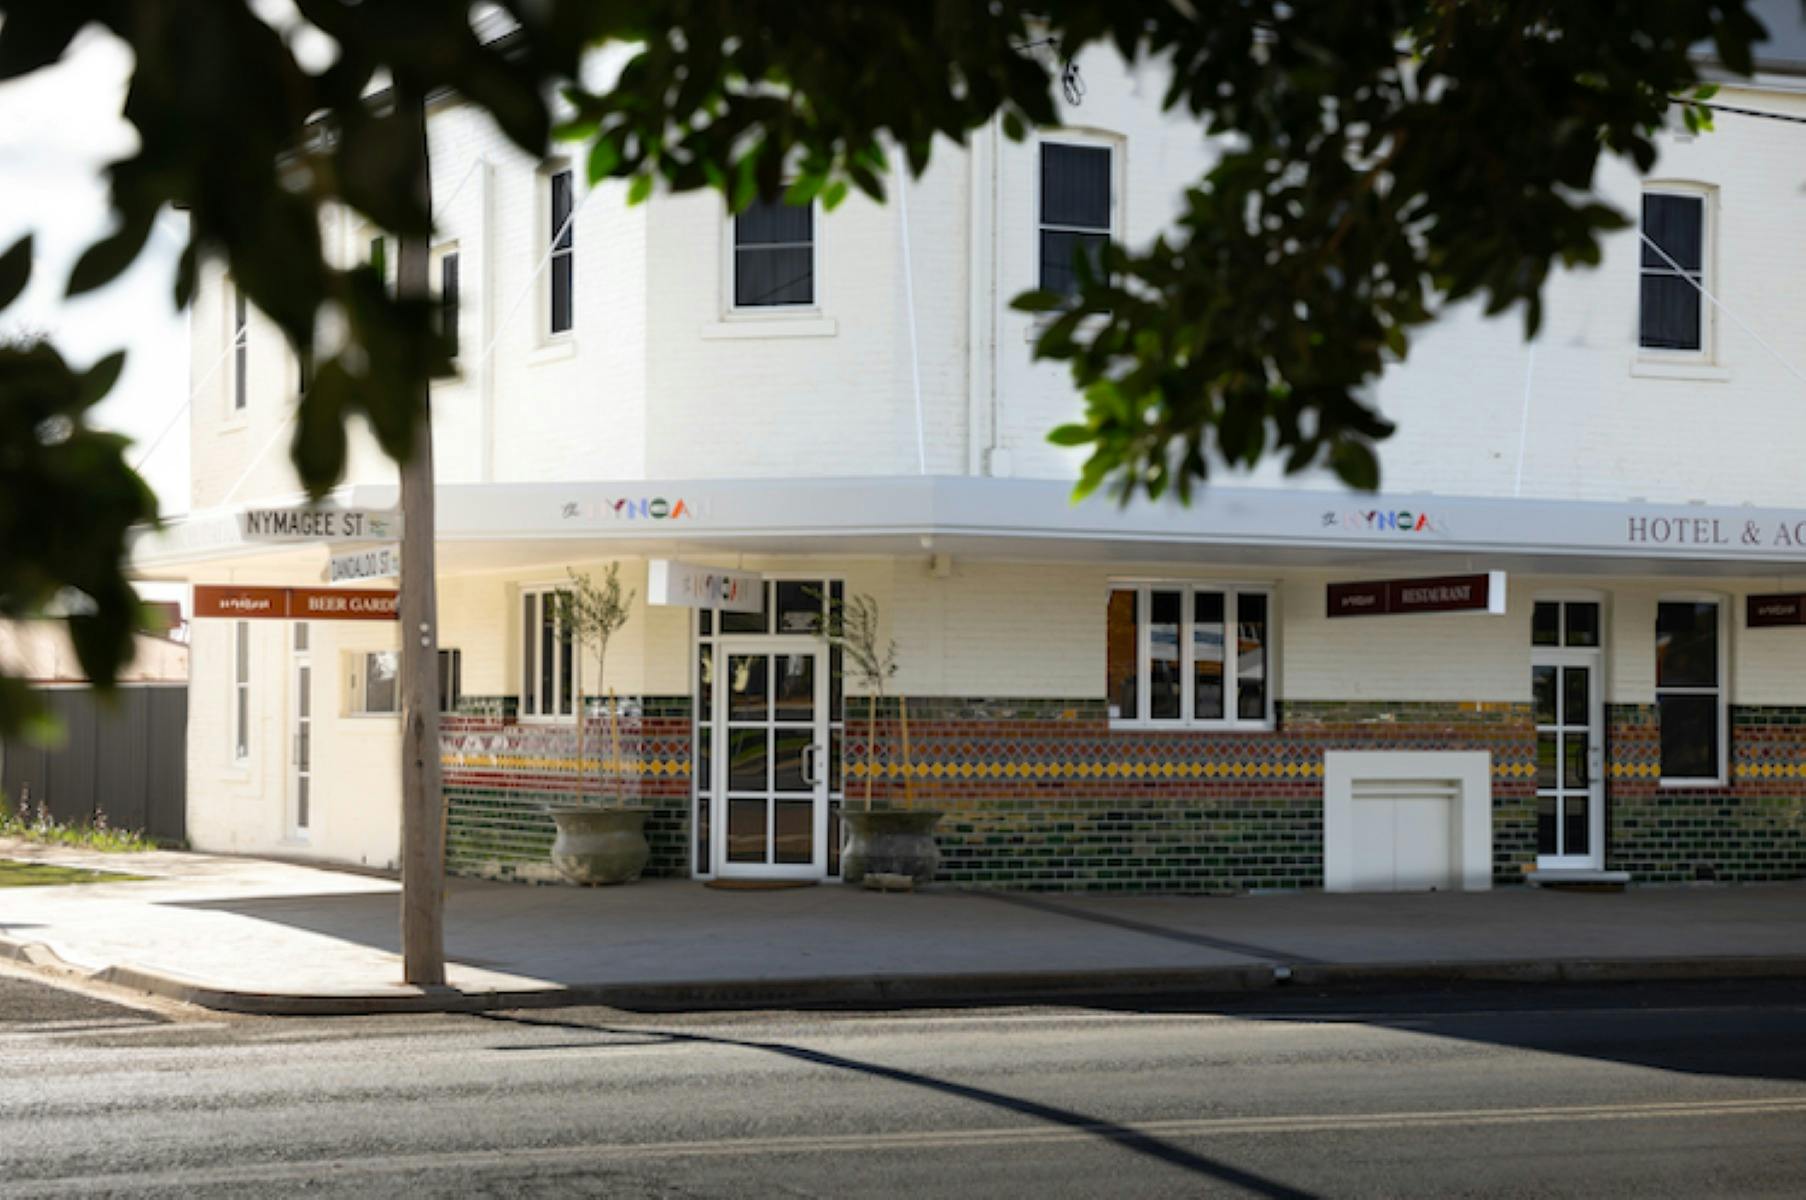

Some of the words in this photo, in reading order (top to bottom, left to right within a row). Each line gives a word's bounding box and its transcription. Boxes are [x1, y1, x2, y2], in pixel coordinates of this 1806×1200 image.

[247, 511, 335, 536] NYMAGEE
[342, 512, 363, 536] ST
[1628, 517, 1729, 544] HOTEL
[1741, 519, 1761, 545] &
[308, 596, 346, 612] BEER
